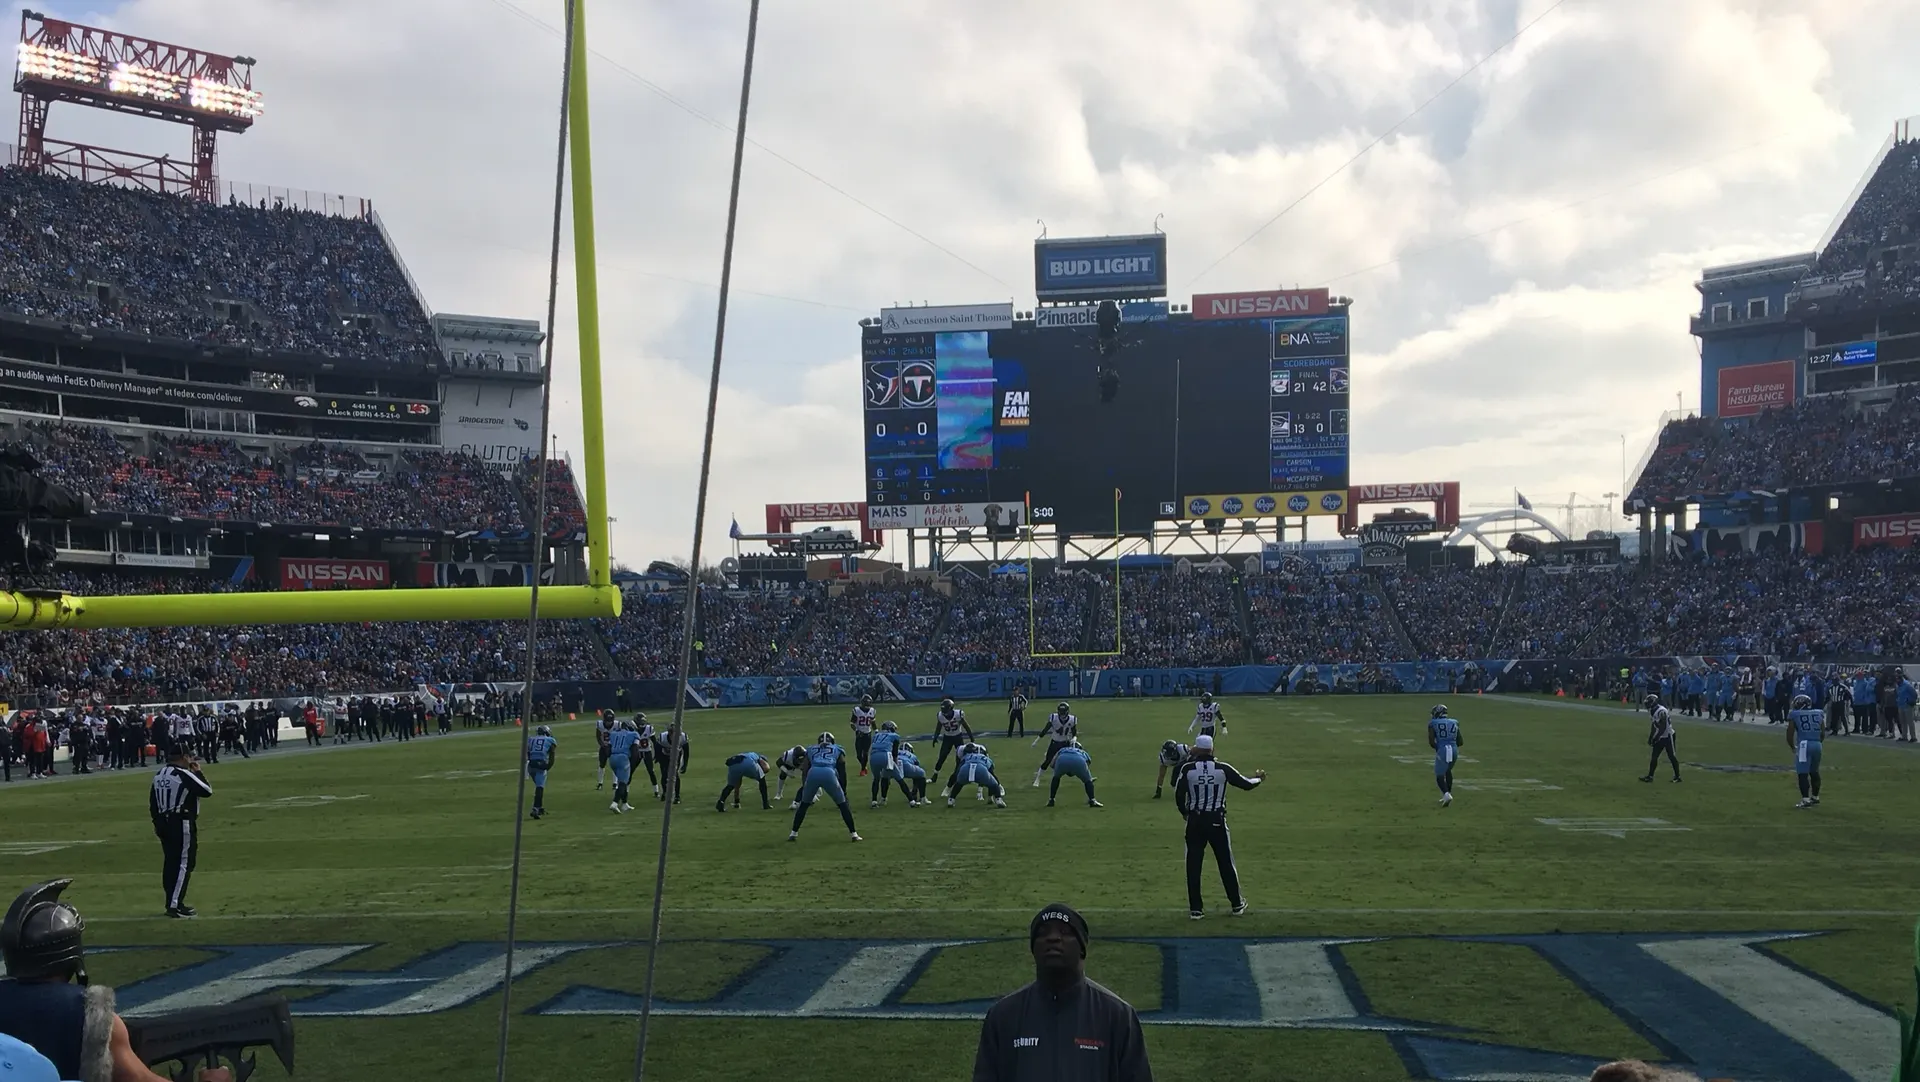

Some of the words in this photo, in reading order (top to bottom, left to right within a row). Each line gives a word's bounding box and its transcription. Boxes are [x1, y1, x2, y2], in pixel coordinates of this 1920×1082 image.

[1050, 260, 1091, 276] BUD
[1094, 257, 1151, 274] LIGHT
[1211, 295, 1309, 315] NISSAN
[902, 316, 949, 326] Ascension
[950, 314, 975, 324] Saint
[976, 313, 1011, 322] Thomas
[1280, 333, 1311, 346] BNA
[1283, 359, 1336, 368] SCOREBOARD
[1809, 354, 1831, 364] 12:27
[5, 369, 15, 377] an
[17, 370, 45, 382] audible
[46, 373, 63, 384] with
[65, 375, 89, 387] FedEx
[91, 378, 123, 392] Delivery
[165, 388, 173, 396] at
[1294, 383, 1305, 393] 21
[1313, 381, 1327, 392] 42
[1728, 386, 1752, 396] Farm
[1753, 383, 1785, 393] Bureau
[1727, 391, 1785, 406] INSURANCE
[331, 401, 338, 409] 0
[352, 410, 373, 419] (DEN)
[458, 416, 505, 425] BRIDGESTONE
[876, 423, 886, 438] 0
[918, 422, 928, 436] 0
[1294, 423, 1305, 434] 13
[1316, 423, 1324, 433] 0
[461, 444, 530, 461] CLUTCH
[877, 468, 884, 477] 6
[925, 467, 929, 476] 1
[877, 481, 884, 490] 9
[924, 480, 930, 489] 4
[1361, 483, 1445, 499] NISSAN
[877, 493, 884, 502] 0
[924, 492, 931, 501] 0
[780, 503, 859, 518] NISSAN
[1190, 503, 1209, 515] Kroger
[1223, 502, 1243, 515] Kroger
[1256, 501, 1276, 514] Kroger
[1289, 500, 1309, 514] Kroger
[1321, 497, 1342, 512] Kroger
[872, 507, 908, 518] MARS
[1034, 507, 1054, 518] 5:00
[1384, 524, 1433, 532] TITAN
[809, 543, 855, 551] TITAN
[287, 564, 384, 581] NISSAN
[927, 678, 940, 686] NFL
[1800, 714, 1821, 732] 85
[531, 738, 546, 751] 19
[614, 735, 626, 749] 11
[812, 747, 835, 761] 22
[157, 780, 171, 788] 102
[1198, 776, 1215, 785] 52
[1042, 911, 1070, 923] WESS
